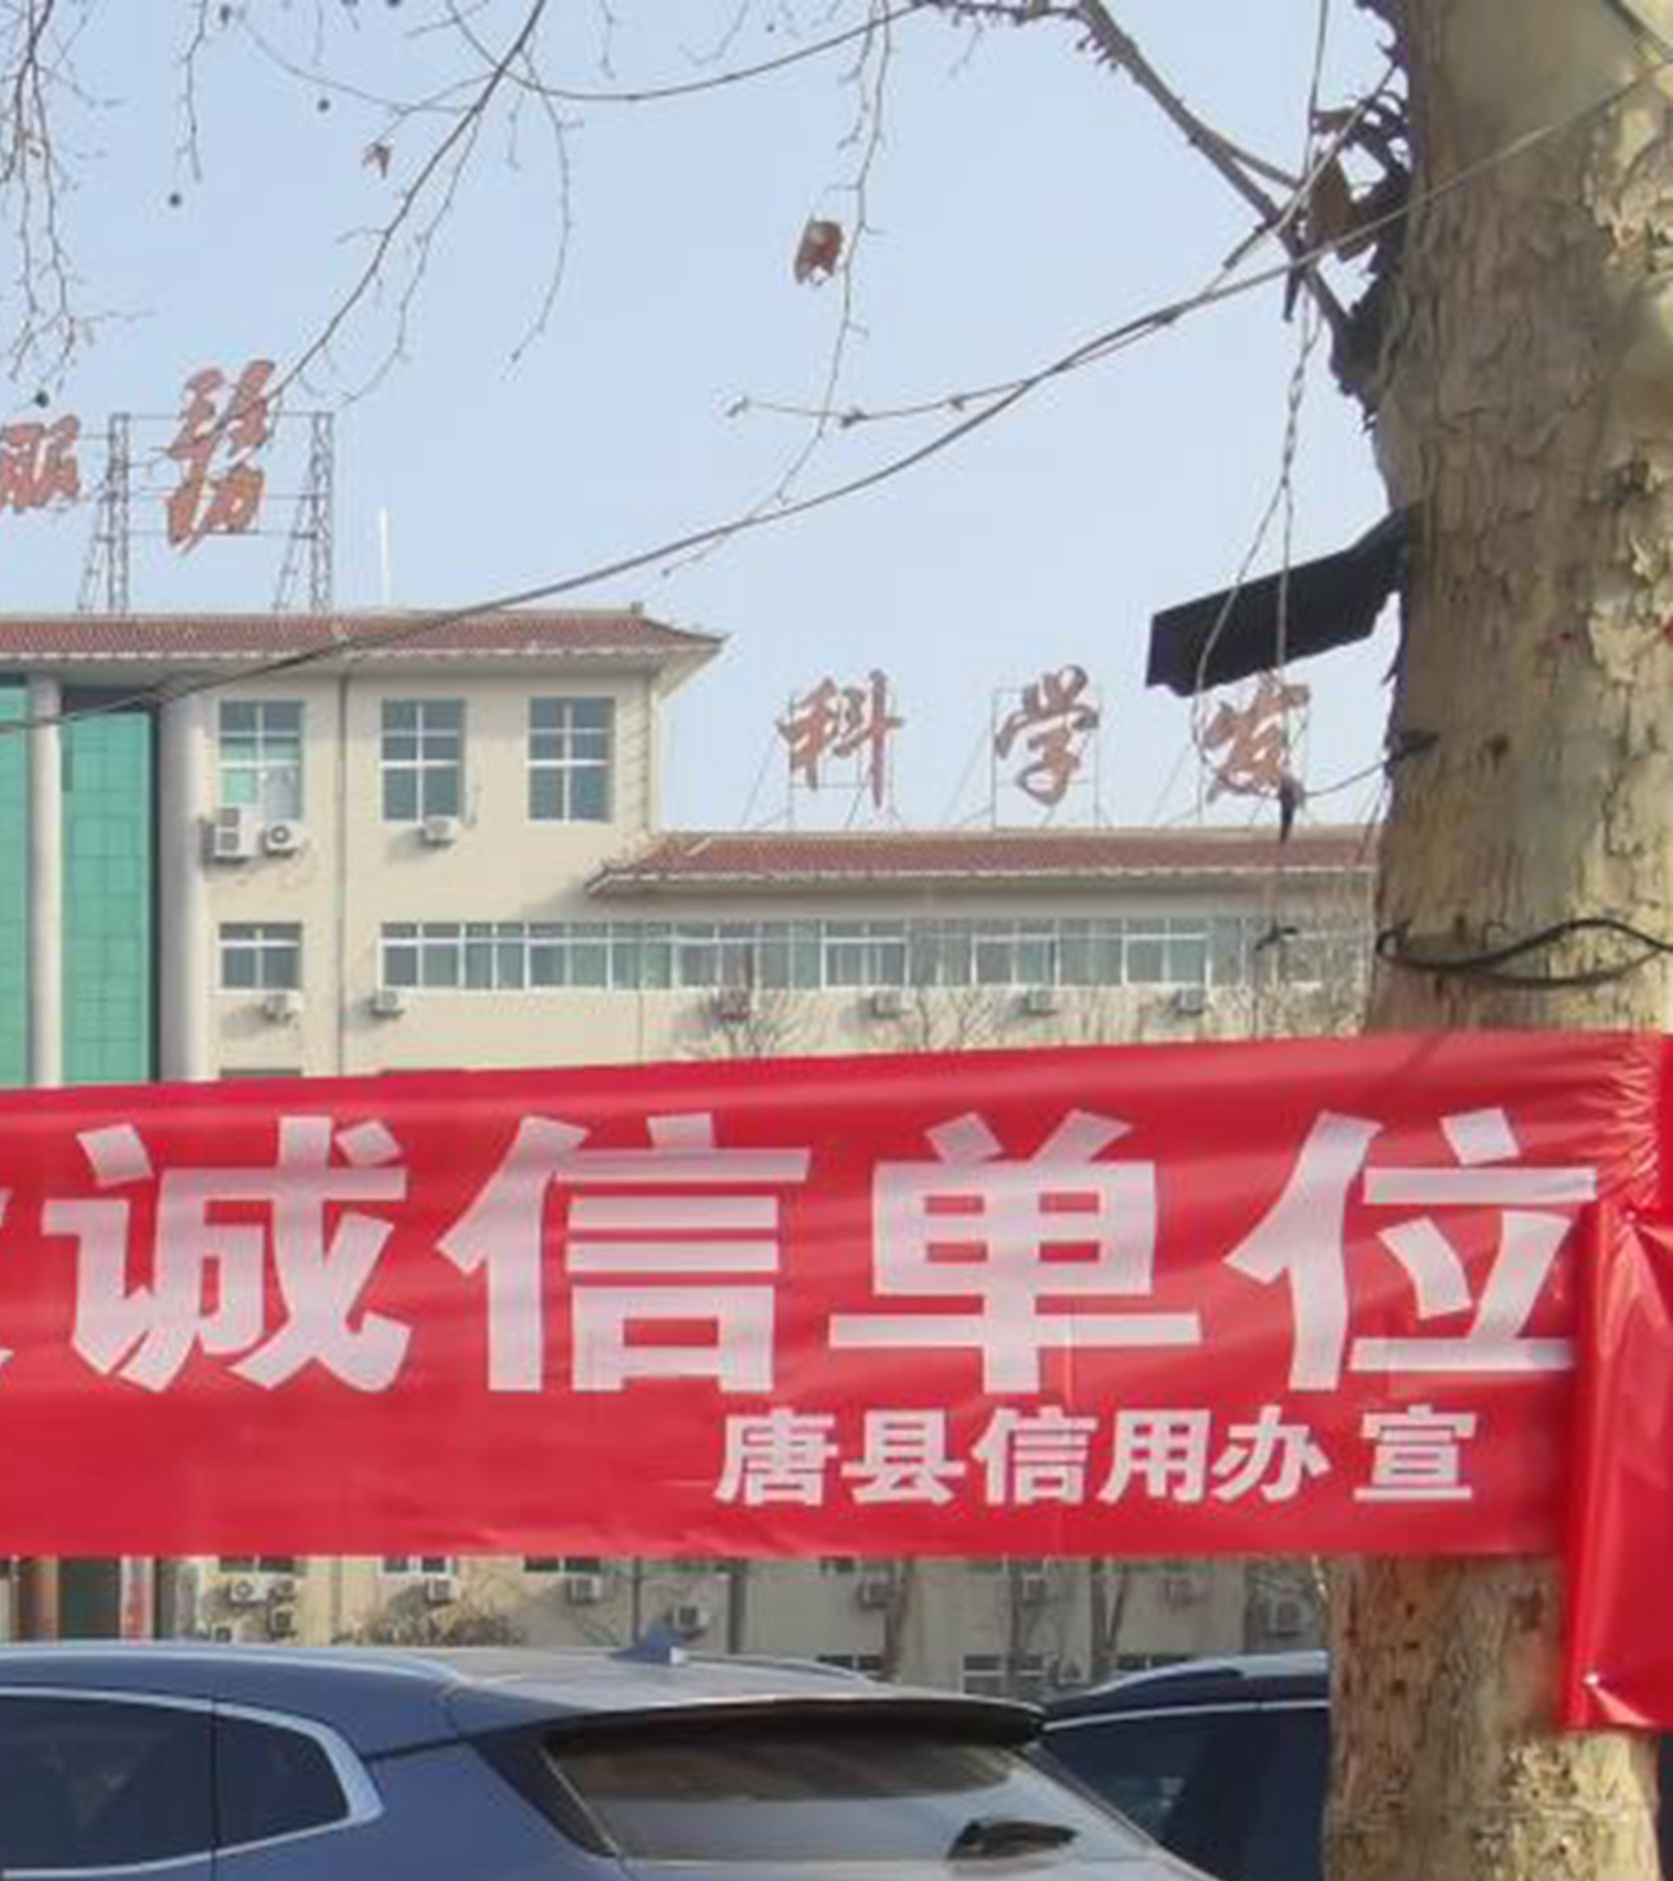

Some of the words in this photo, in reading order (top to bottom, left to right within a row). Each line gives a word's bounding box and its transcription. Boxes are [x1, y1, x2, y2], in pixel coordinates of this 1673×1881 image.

[715, 1406, 1330, 1507] 唐县信用办
[1354, 1406, 1478, 1503] 宣
